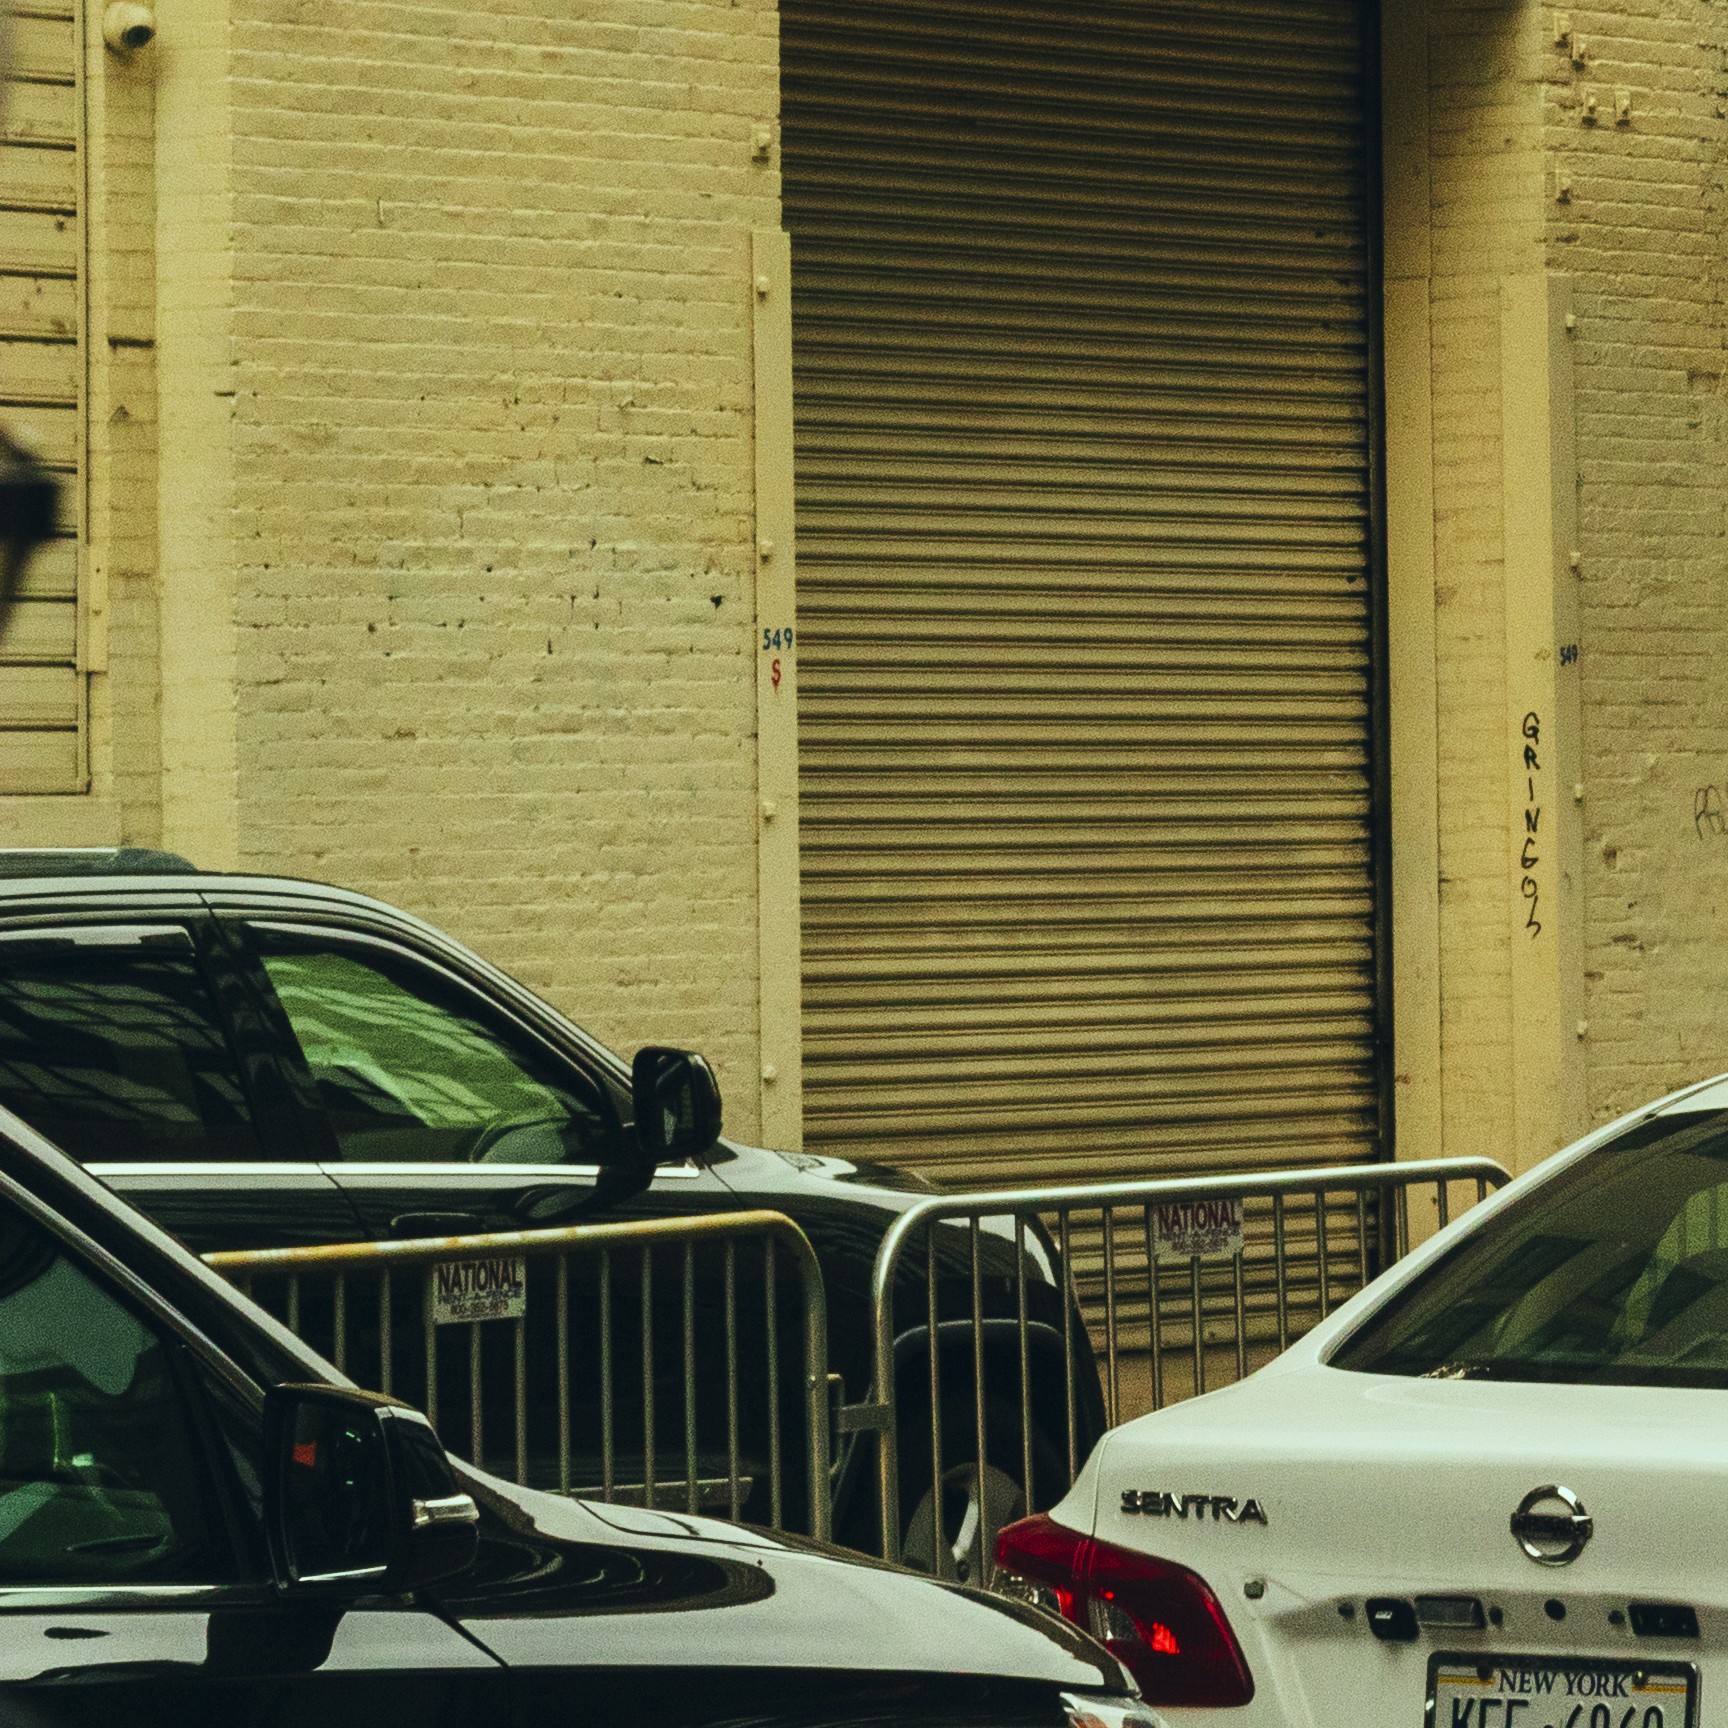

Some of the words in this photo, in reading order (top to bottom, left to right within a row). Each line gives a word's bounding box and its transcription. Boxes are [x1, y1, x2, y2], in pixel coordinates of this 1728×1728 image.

[762, 627, 793, 651] 549
[1158, 1199, 1242, 1234] NATIONAL
[437, 1258, 524, 1295] NATIONAL
[1119, 1488, 1269, 1526] SENTRA
[1498, 1669, 1557, 1695] NEW
[1563, 1672, 1630, 1698] YORK
